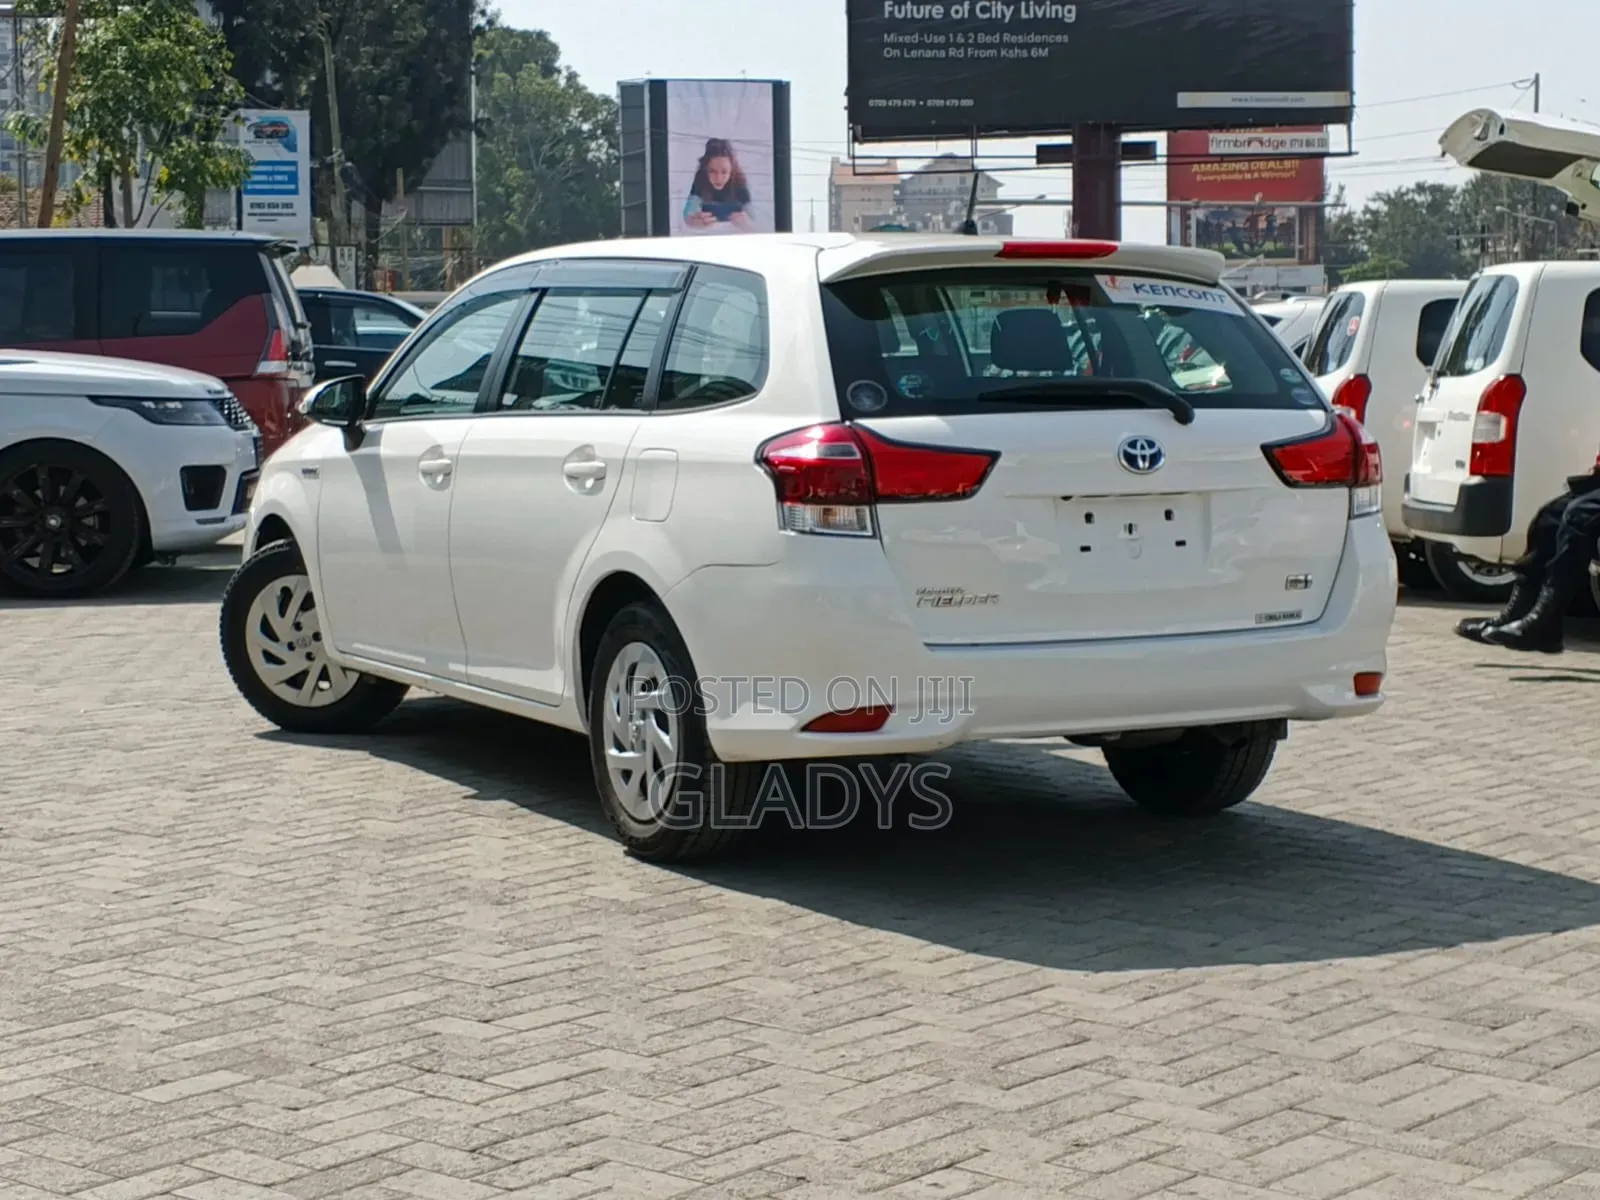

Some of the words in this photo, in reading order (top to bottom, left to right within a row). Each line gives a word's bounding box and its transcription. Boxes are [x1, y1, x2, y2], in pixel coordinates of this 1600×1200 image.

[884, 1, 944, 19] Future
[950, 1, 970, 19] of
[975, 1, 1014, 23] City
[1021, 1, 1077, 23] Living
[883, 33, 946, 43] Mixed-Use
[956, 33, 965, 43] &
[968, 33, 975, 43] 2
[977, 33, 1000, 43] Bed
[1003, 33, 1069, 43] Residences
[883, 47, 900, 58] On
[904, 47, 946, 58] Lenana
[949, 47, 964, 58] Rd
[968, 47, 997, 58] From
[1000, 47, 1028, 58] Kshs
[1031, 47, 1049, 58] 6M
[1192, 162, 1249, 173] AMAZING
